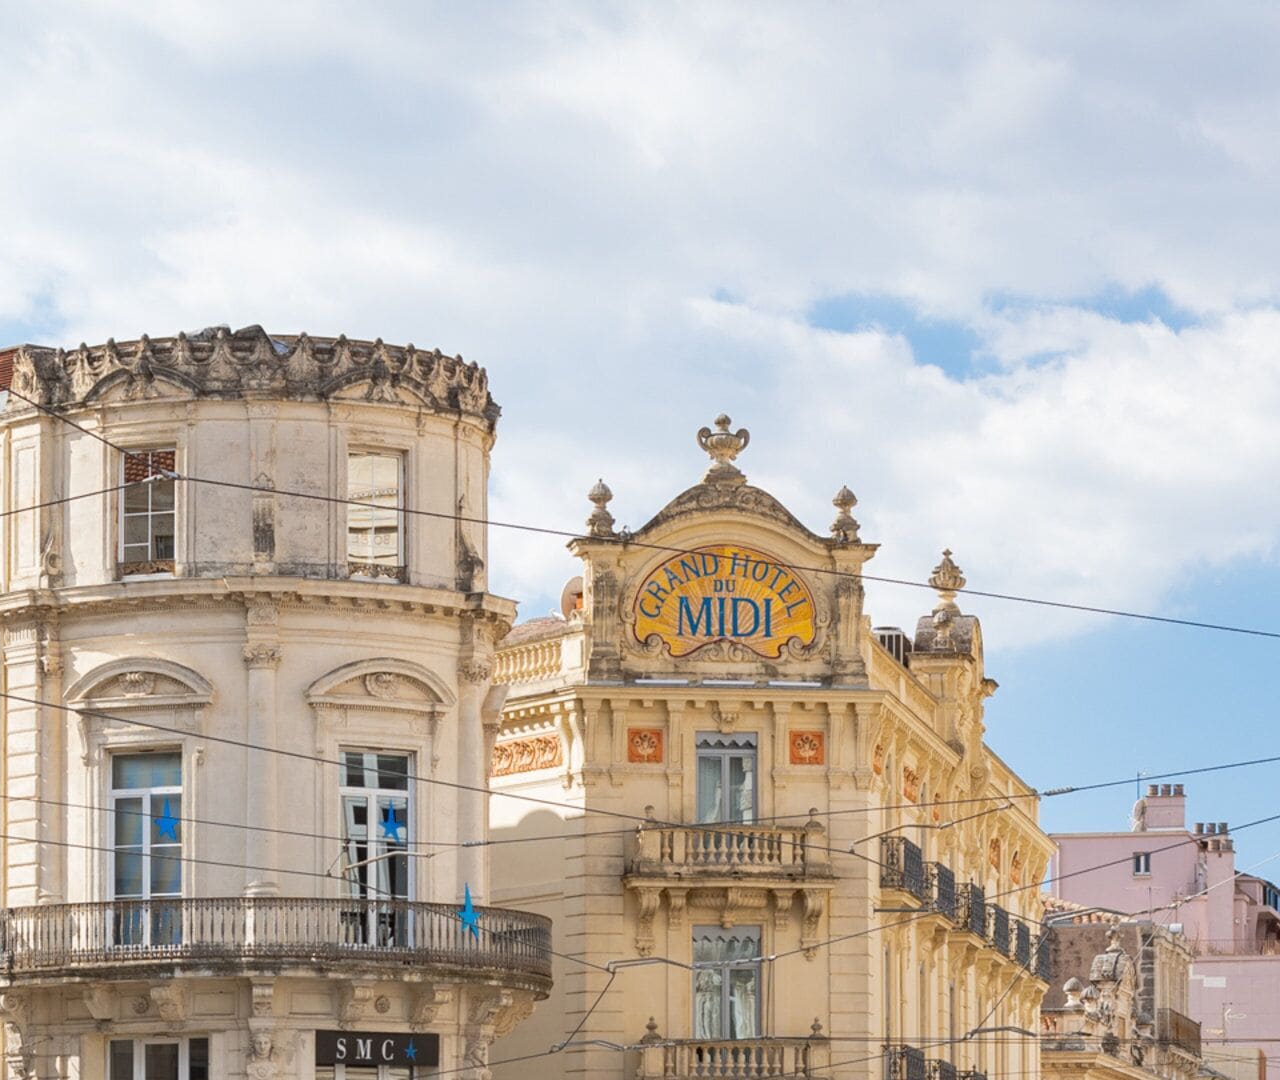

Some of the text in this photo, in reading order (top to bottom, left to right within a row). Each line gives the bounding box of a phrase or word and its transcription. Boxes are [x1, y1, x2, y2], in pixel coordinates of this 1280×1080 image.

[639, 552, 808, 619] GRAND HOTEL
[713, 579, 736, 593] DU
[677, 595, 773, 638] MIDI
[336, 1038, 394, 1060] SMC
